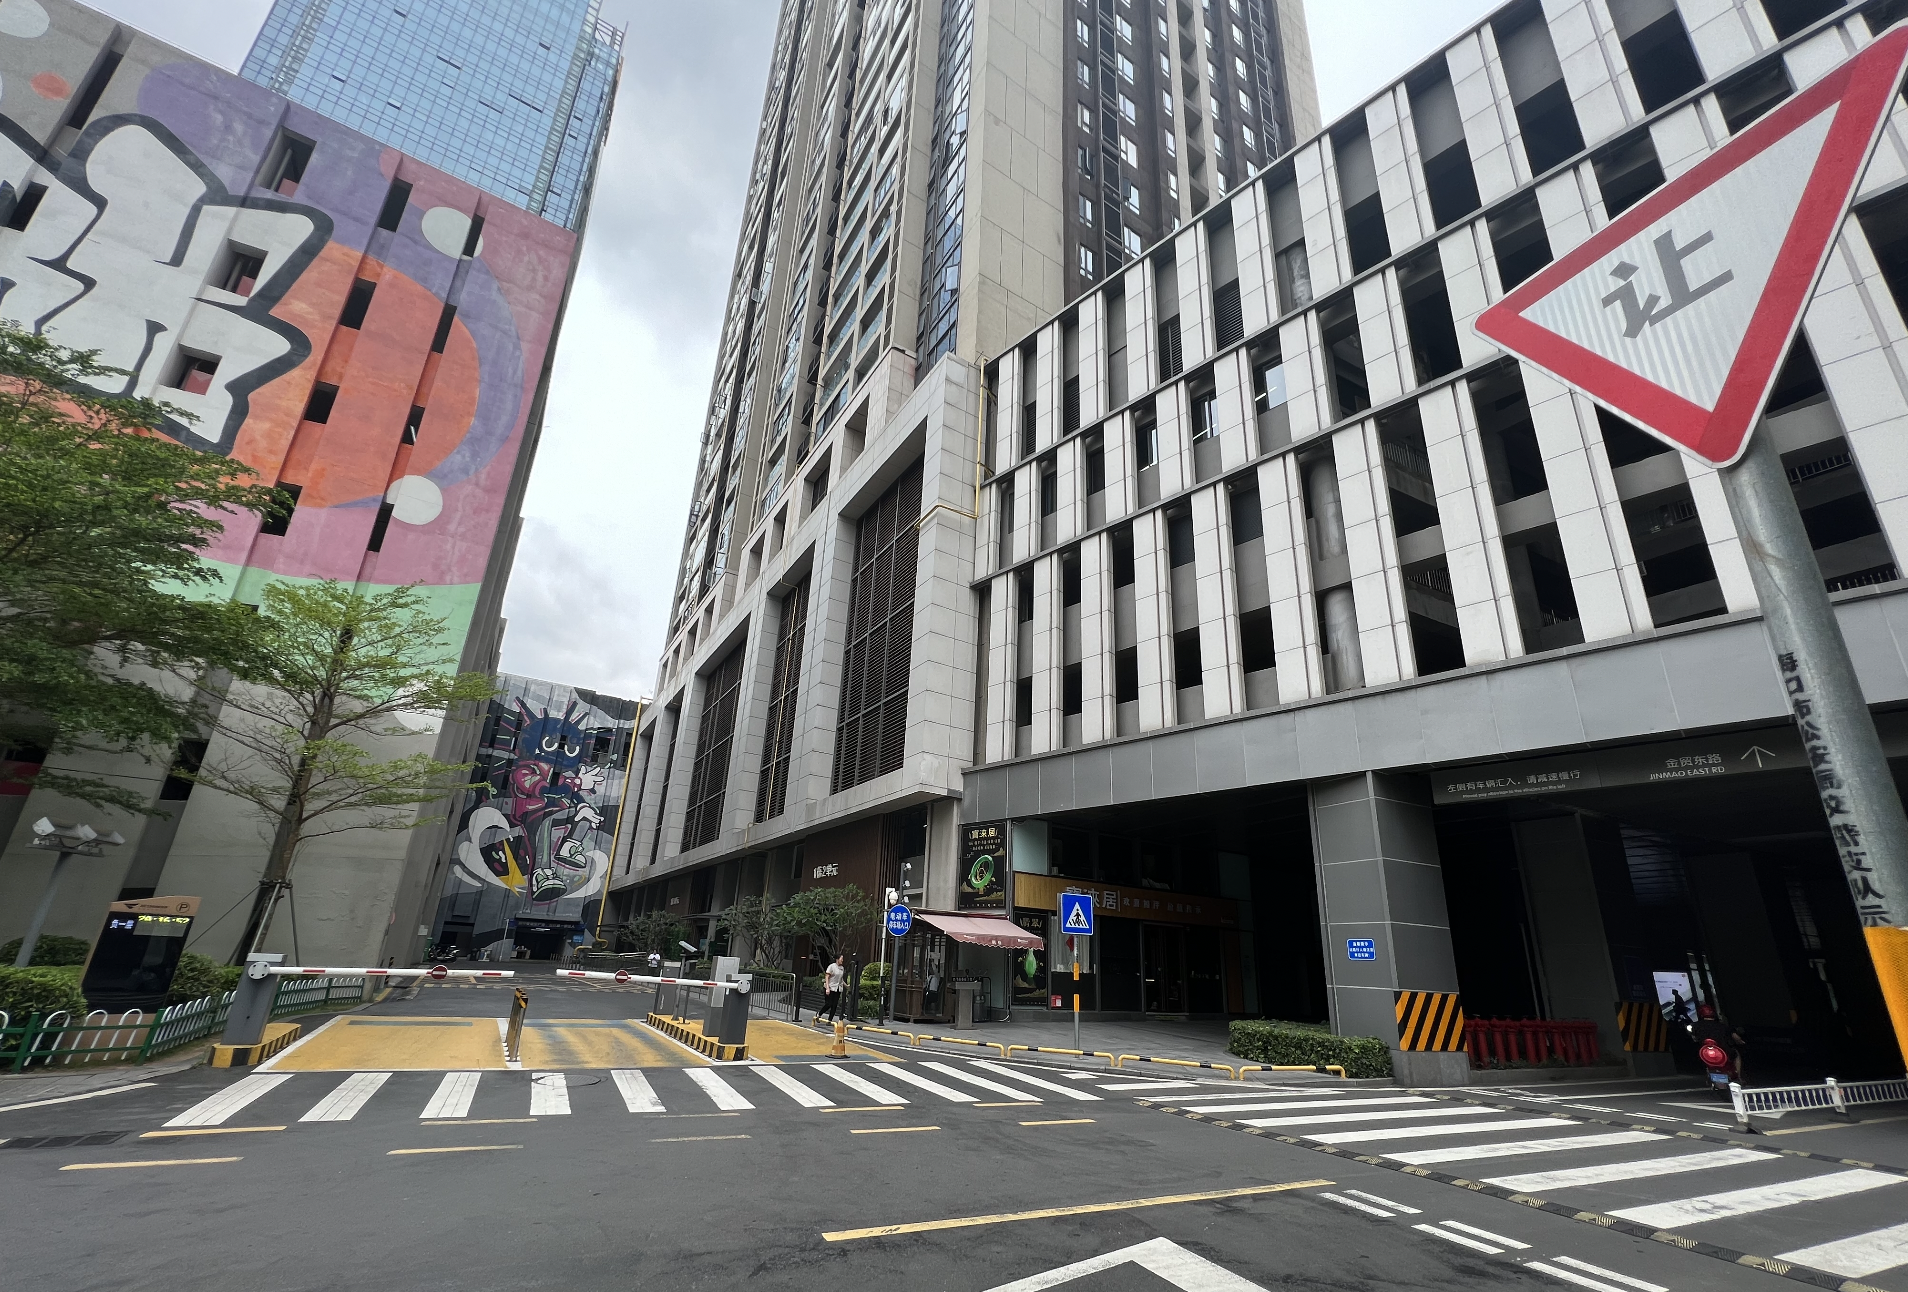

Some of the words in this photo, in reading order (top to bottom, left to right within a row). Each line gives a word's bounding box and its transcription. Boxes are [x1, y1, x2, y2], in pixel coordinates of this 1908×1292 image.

[1601, 228, 1734, 339] 让
[1665, 753, 1722, 768] 金贸东路
[1650, 770, 1685, 780] JINMAO
[1687, 767, 1710, 776] EAST
[1711, 766, 1725, 774] RD
[890, 911, 909, 921] 电动车
[889, 920, 909, 930] 停车场入口
